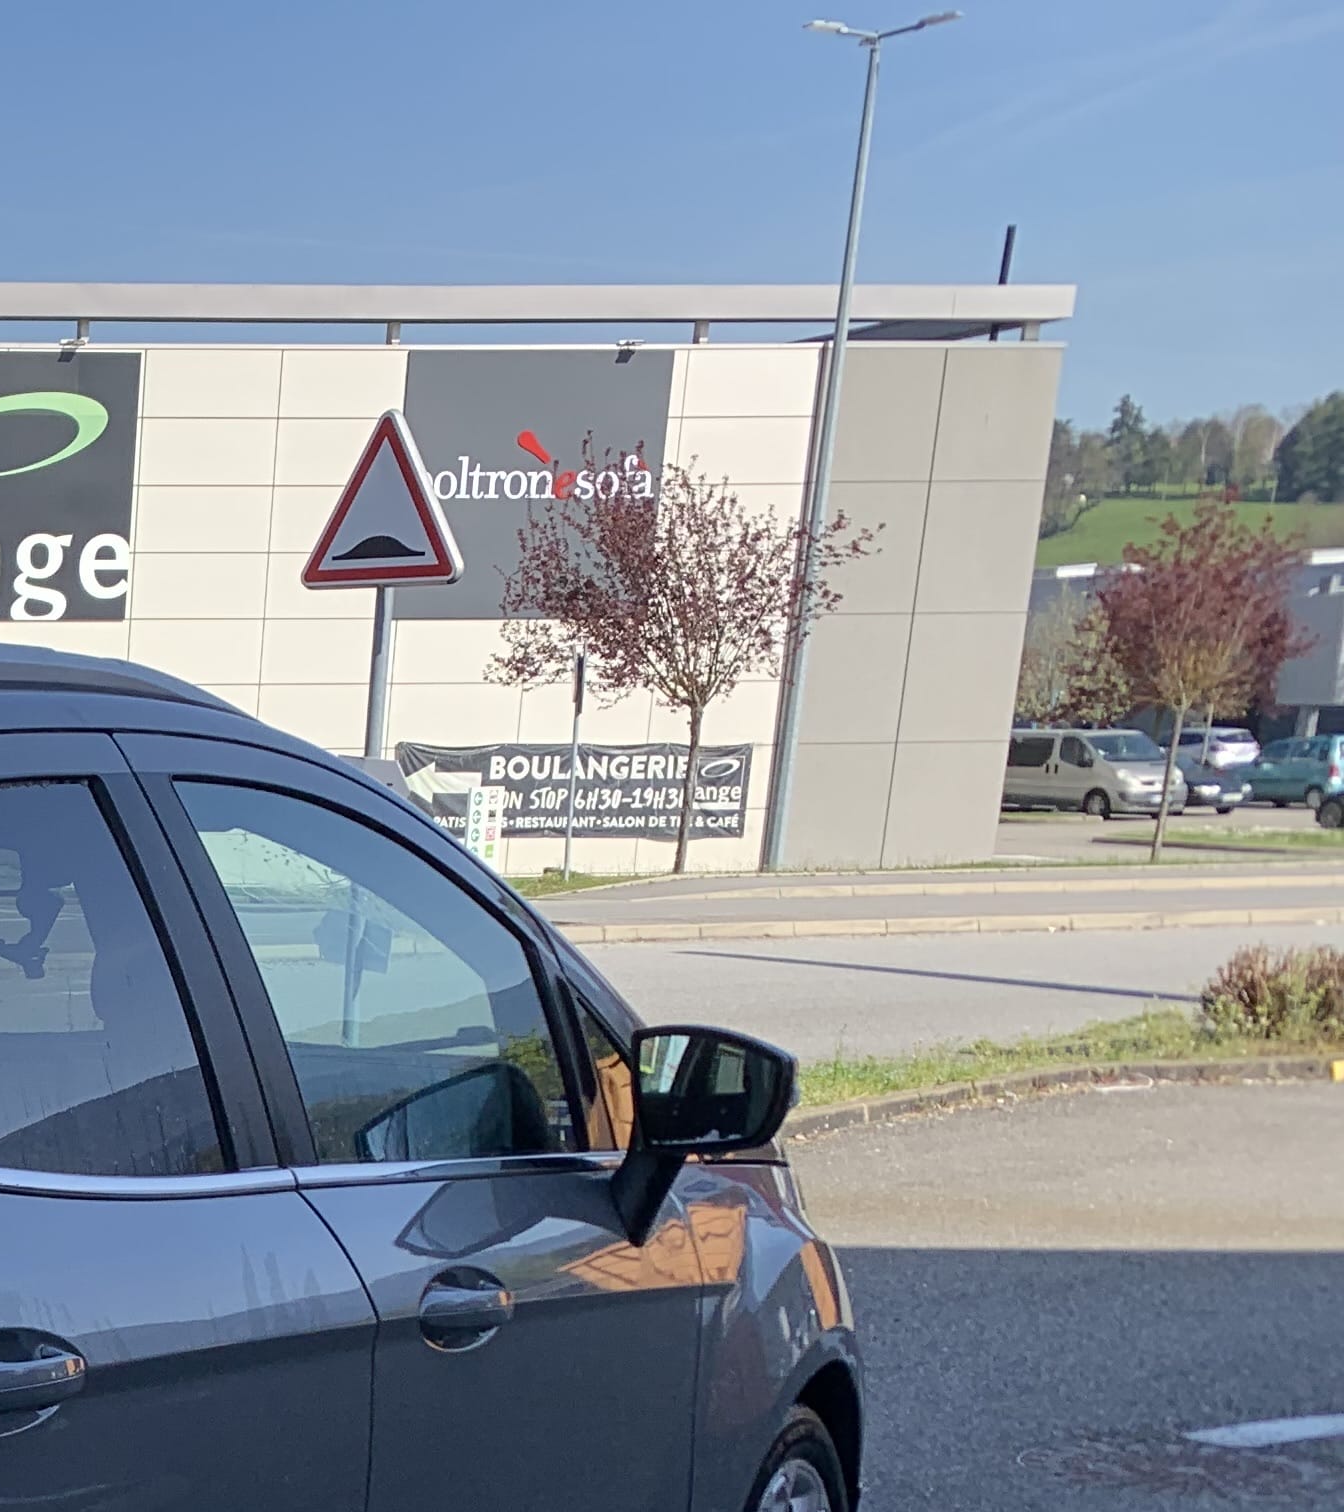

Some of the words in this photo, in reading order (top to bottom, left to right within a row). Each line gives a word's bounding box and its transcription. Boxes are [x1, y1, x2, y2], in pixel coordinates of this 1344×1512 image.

[489, 754, 690, 781] BOULANGERIE
[529, 786, 568, 811] STOP
[694, 785, 742, 804] ange
[602, 815, 645, 829] SALON
[648, 815, 667, 828] DE
[695, 815, 705, 828] &
[706, 812, 740, 828] CAFÉ
